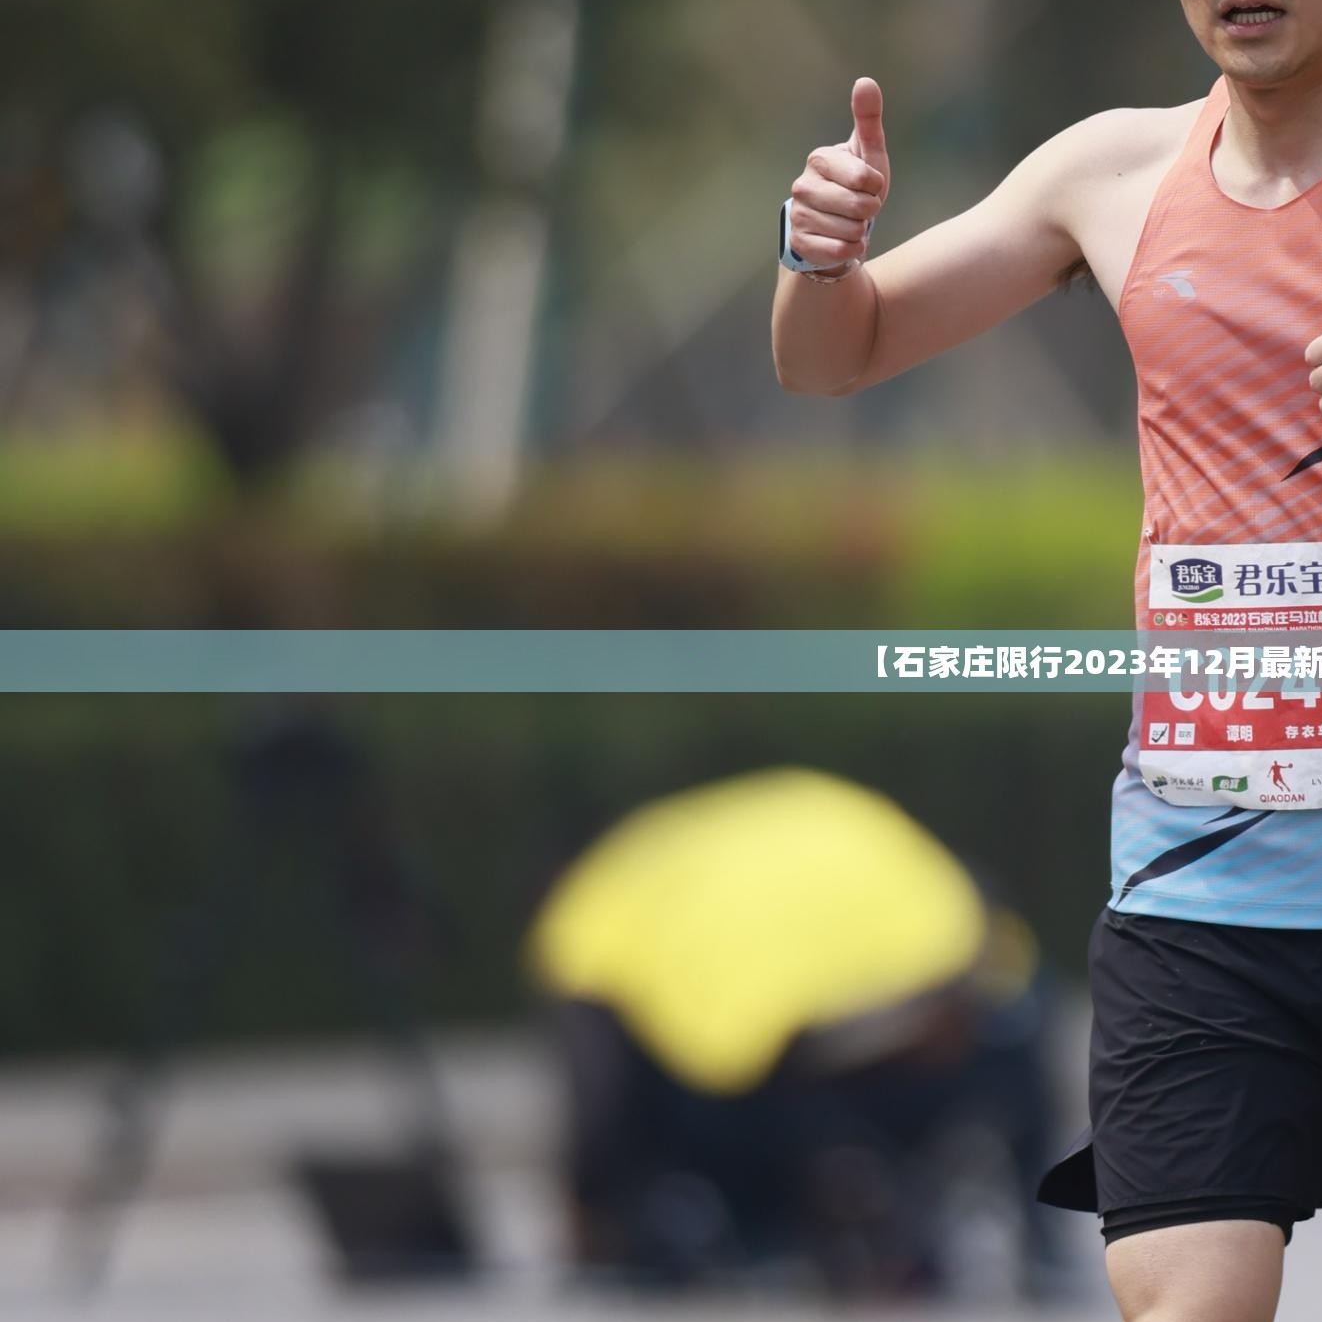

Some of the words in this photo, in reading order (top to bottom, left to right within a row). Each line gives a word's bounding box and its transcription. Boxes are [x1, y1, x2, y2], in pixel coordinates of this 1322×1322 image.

[1175, 564, 1217, 584] 君乐宝
[1259, 793, 1306, 803] QIAODAN
